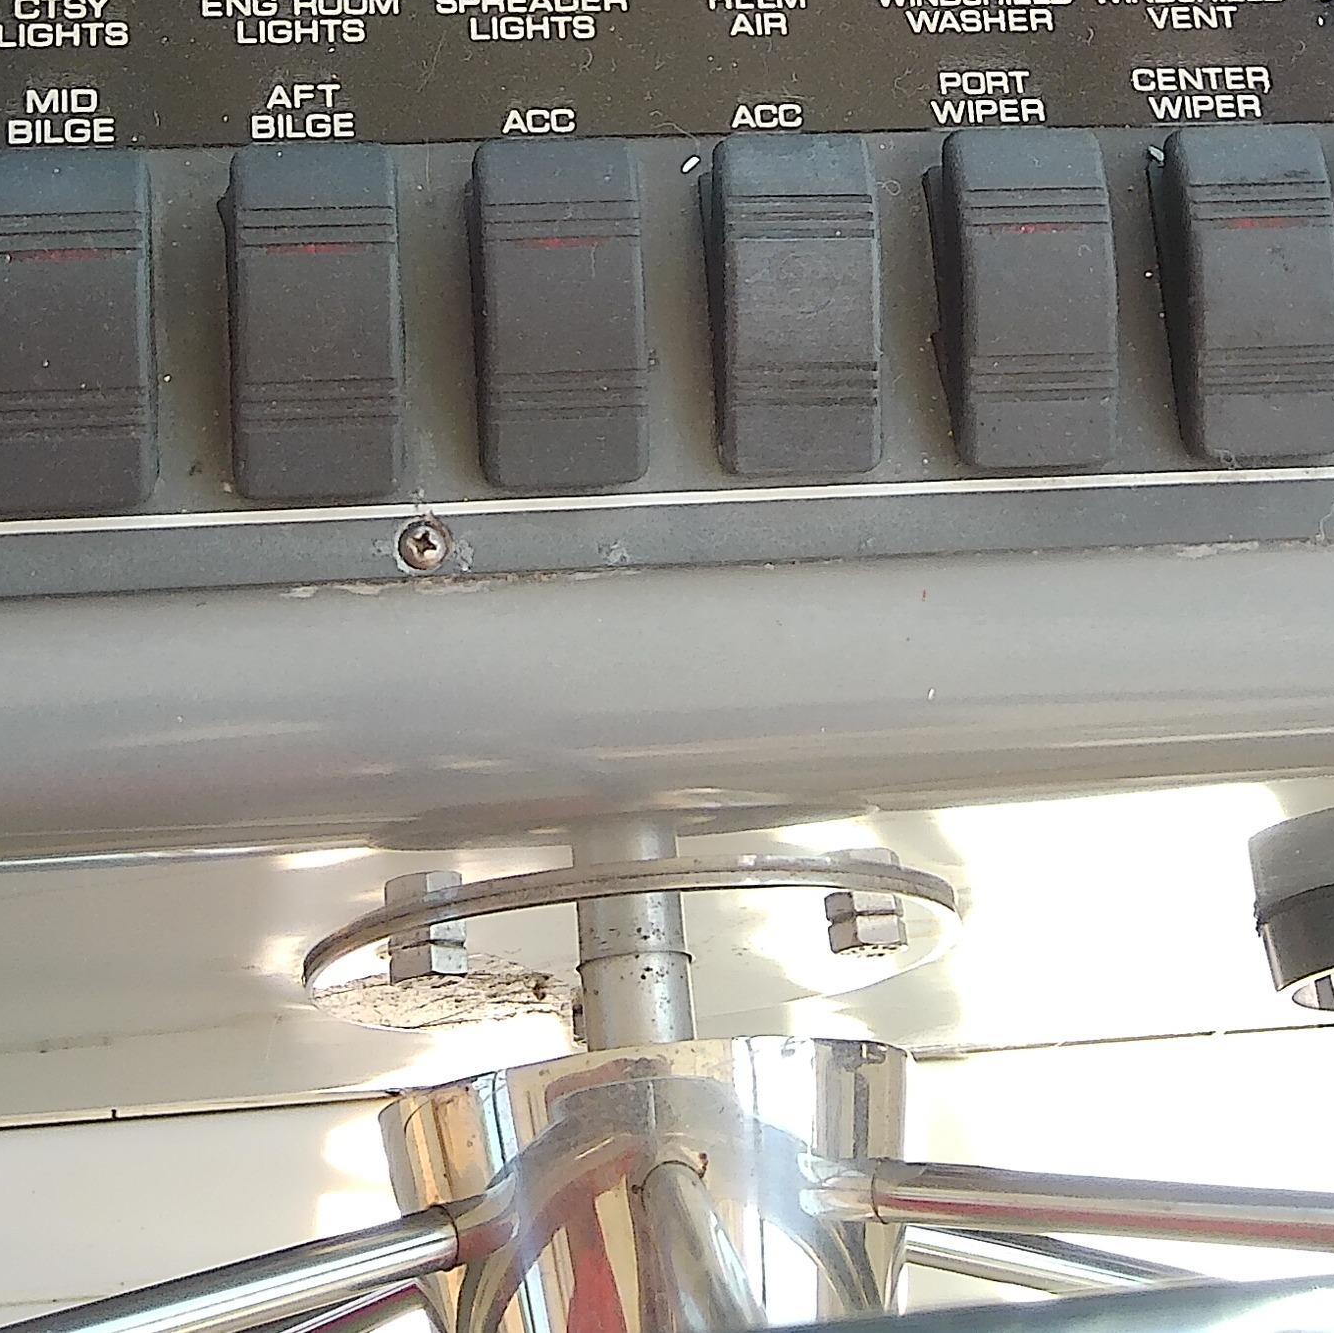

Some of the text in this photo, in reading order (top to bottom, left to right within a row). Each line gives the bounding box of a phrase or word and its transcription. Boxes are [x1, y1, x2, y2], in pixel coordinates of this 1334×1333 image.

[470, 15, 596, 41] LIGHTS
[730, 12, 789, 36] AIR
[906, 8, 1054, 33] WASHER
[1148, 6, 1238, 30] VENT
[237, 19, 365, 45] LIGHTS
[940, 70, 1029, 96] PORT
[1131, 66, 1270, 93] CENTER
[26, 88, 98, 114] MID
[267, 84, 341, 111] AFT
[1149, 95, 1262, 120] WIPER
[502, 108, 576, 135] ACC
[732, 103, 803, 129] ACC
[931, 98, 1046, 124] WIPER
[8, 117, 115, 146] BILGE
[251, 112, 354, 139] BILGE
